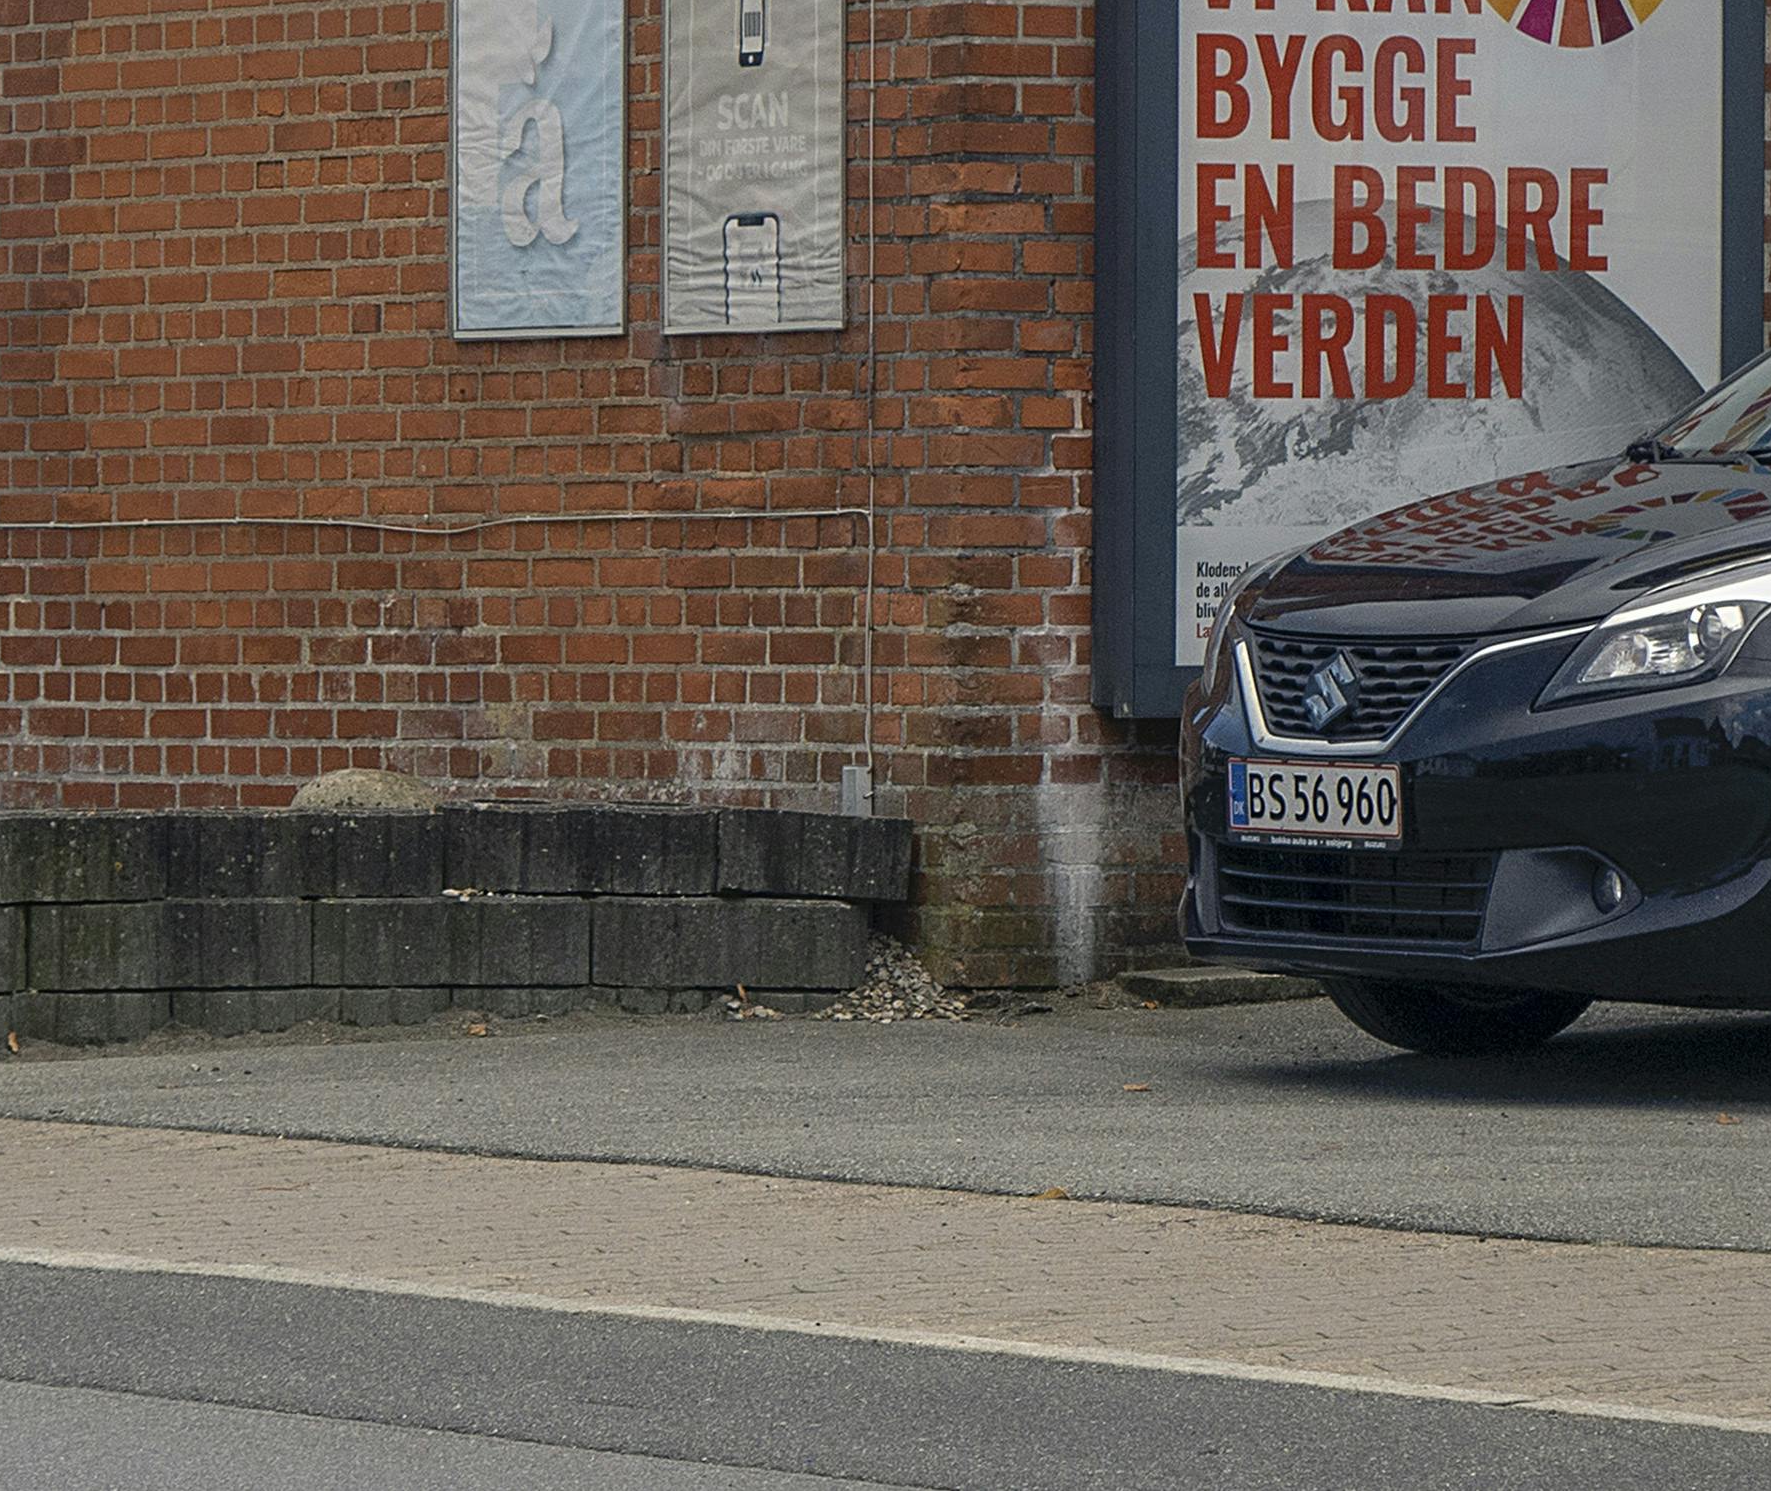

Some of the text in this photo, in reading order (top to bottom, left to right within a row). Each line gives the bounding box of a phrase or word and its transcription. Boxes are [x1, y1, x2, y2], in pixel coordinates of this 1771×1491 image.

[1194, 32, 1478, 144] BYGGE
[717, 91, 790, 131] SCAN
[1194, 162, 1610, 273] EN BEDRE
[1193, 292, 1526, 401] VERDEN
[1196, 562, 1242, 578] Klodens
[1196, 582, 1210, 598] de
[1196, 602, 1218, 619] bliv
[1233, 800, 1246, 816] DK
[1248, 771, 1396, 827] BS 56 960
